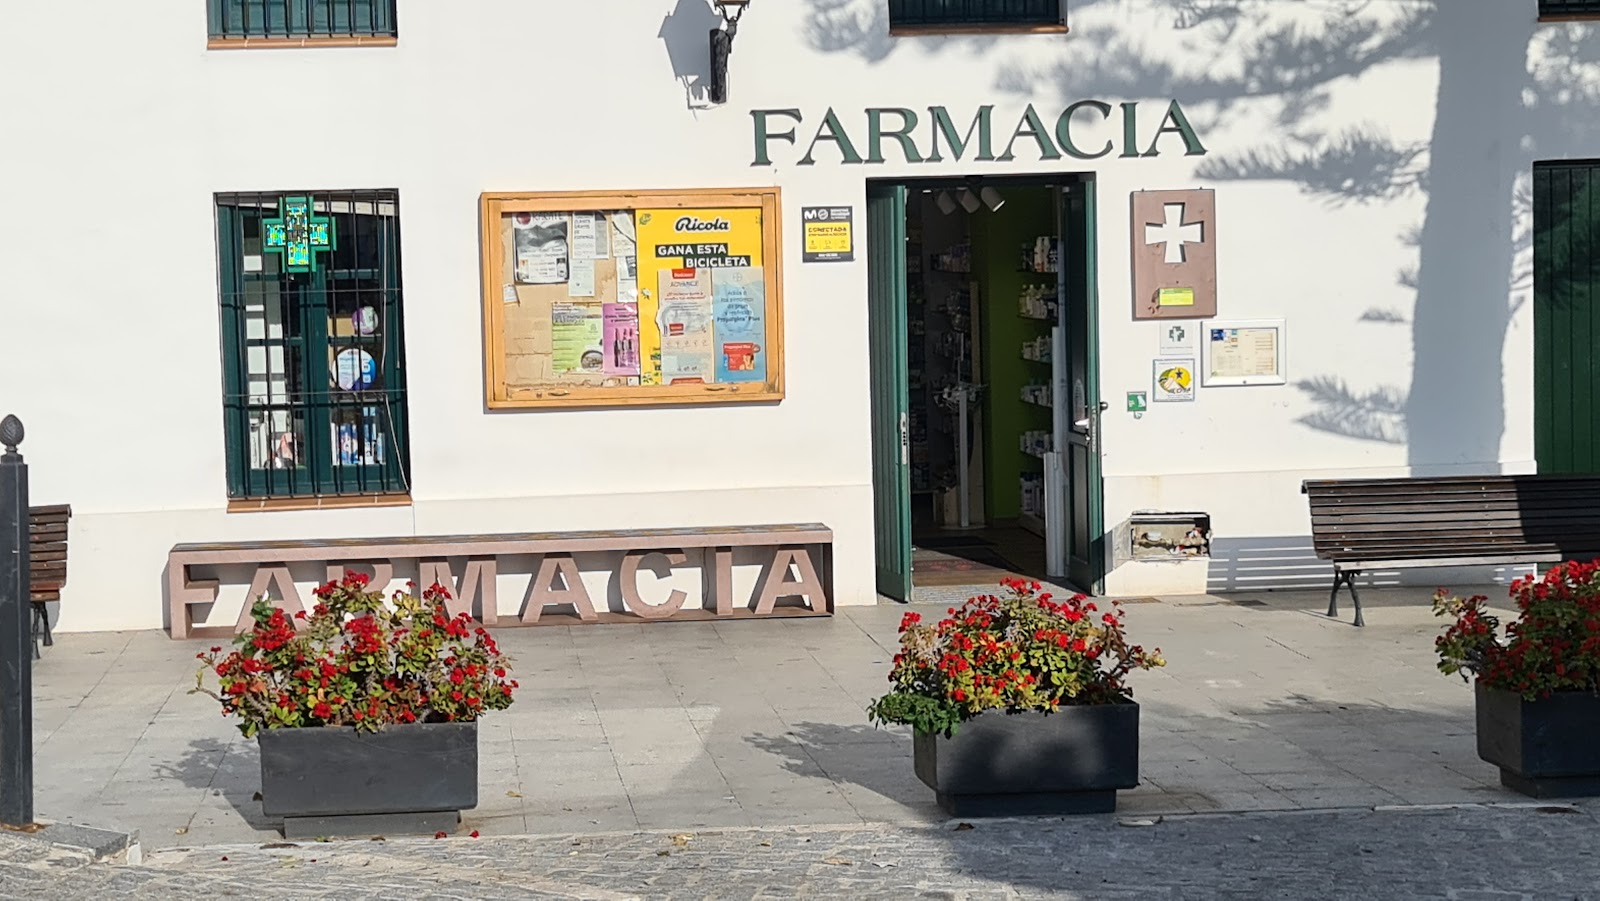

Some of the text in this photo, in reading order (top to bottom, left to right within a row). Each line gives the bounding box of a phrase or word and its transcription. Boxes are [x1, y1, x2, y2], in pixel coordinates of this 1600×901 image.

[749, 98, 1208, 167] FARMACIA
[675, 217, 729, 232] Ricola
[657, 244, 727, 256] GANA ESTA
[685, 256, 748, 269] BICICLETA
